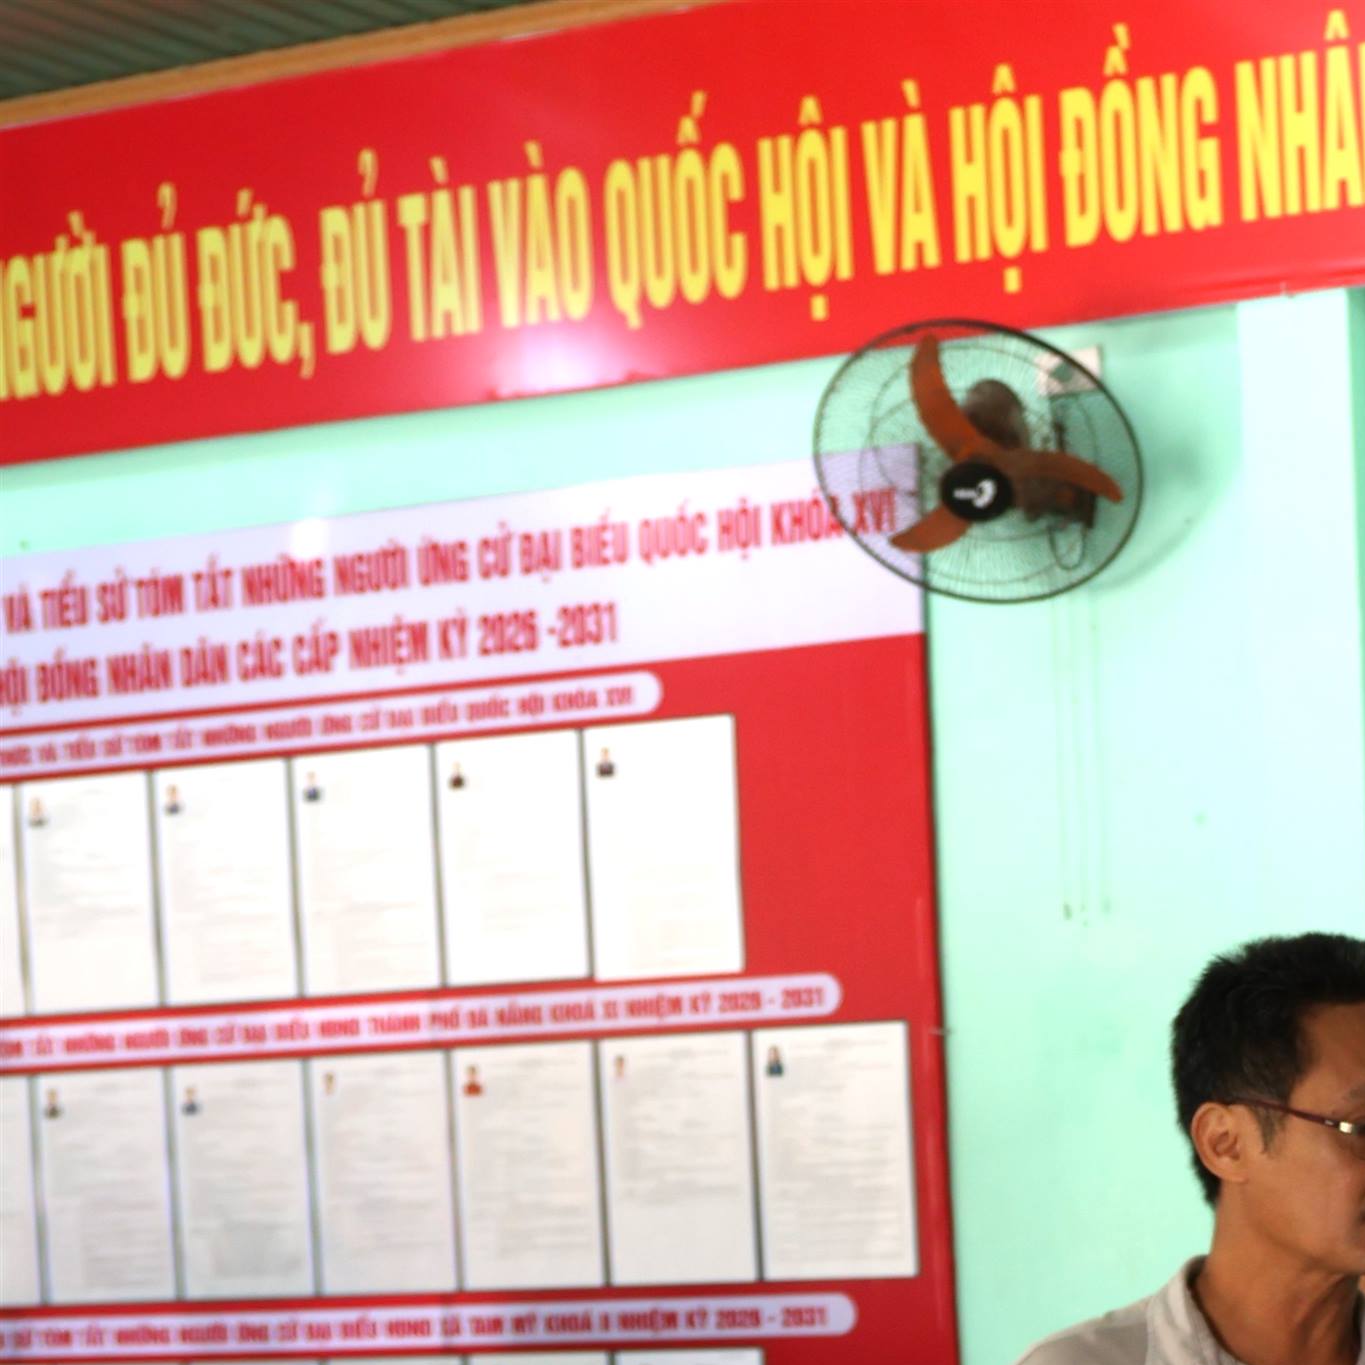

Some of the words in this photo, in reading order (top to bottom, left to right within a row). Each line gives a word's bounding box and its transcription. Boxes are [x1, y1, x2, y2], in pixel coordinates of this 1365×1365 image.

[121, 182, 190, 379] ĐỦ
[197, 188, 315, 379] ĐỨC,
[321, 149, 392, 353] ĐỦ
[400, 157, 482, 342] TÀI
[488, 142, 592, 328] VÀO
[605, 90, 746, 330] QUỐC
[757, 96, 853, 321] HỘI
[861, 79, 941, 275] VÀ
[949, 63, 1047, 293] HỘI
[1060, 23, 1221, 248] ĐỒNG
